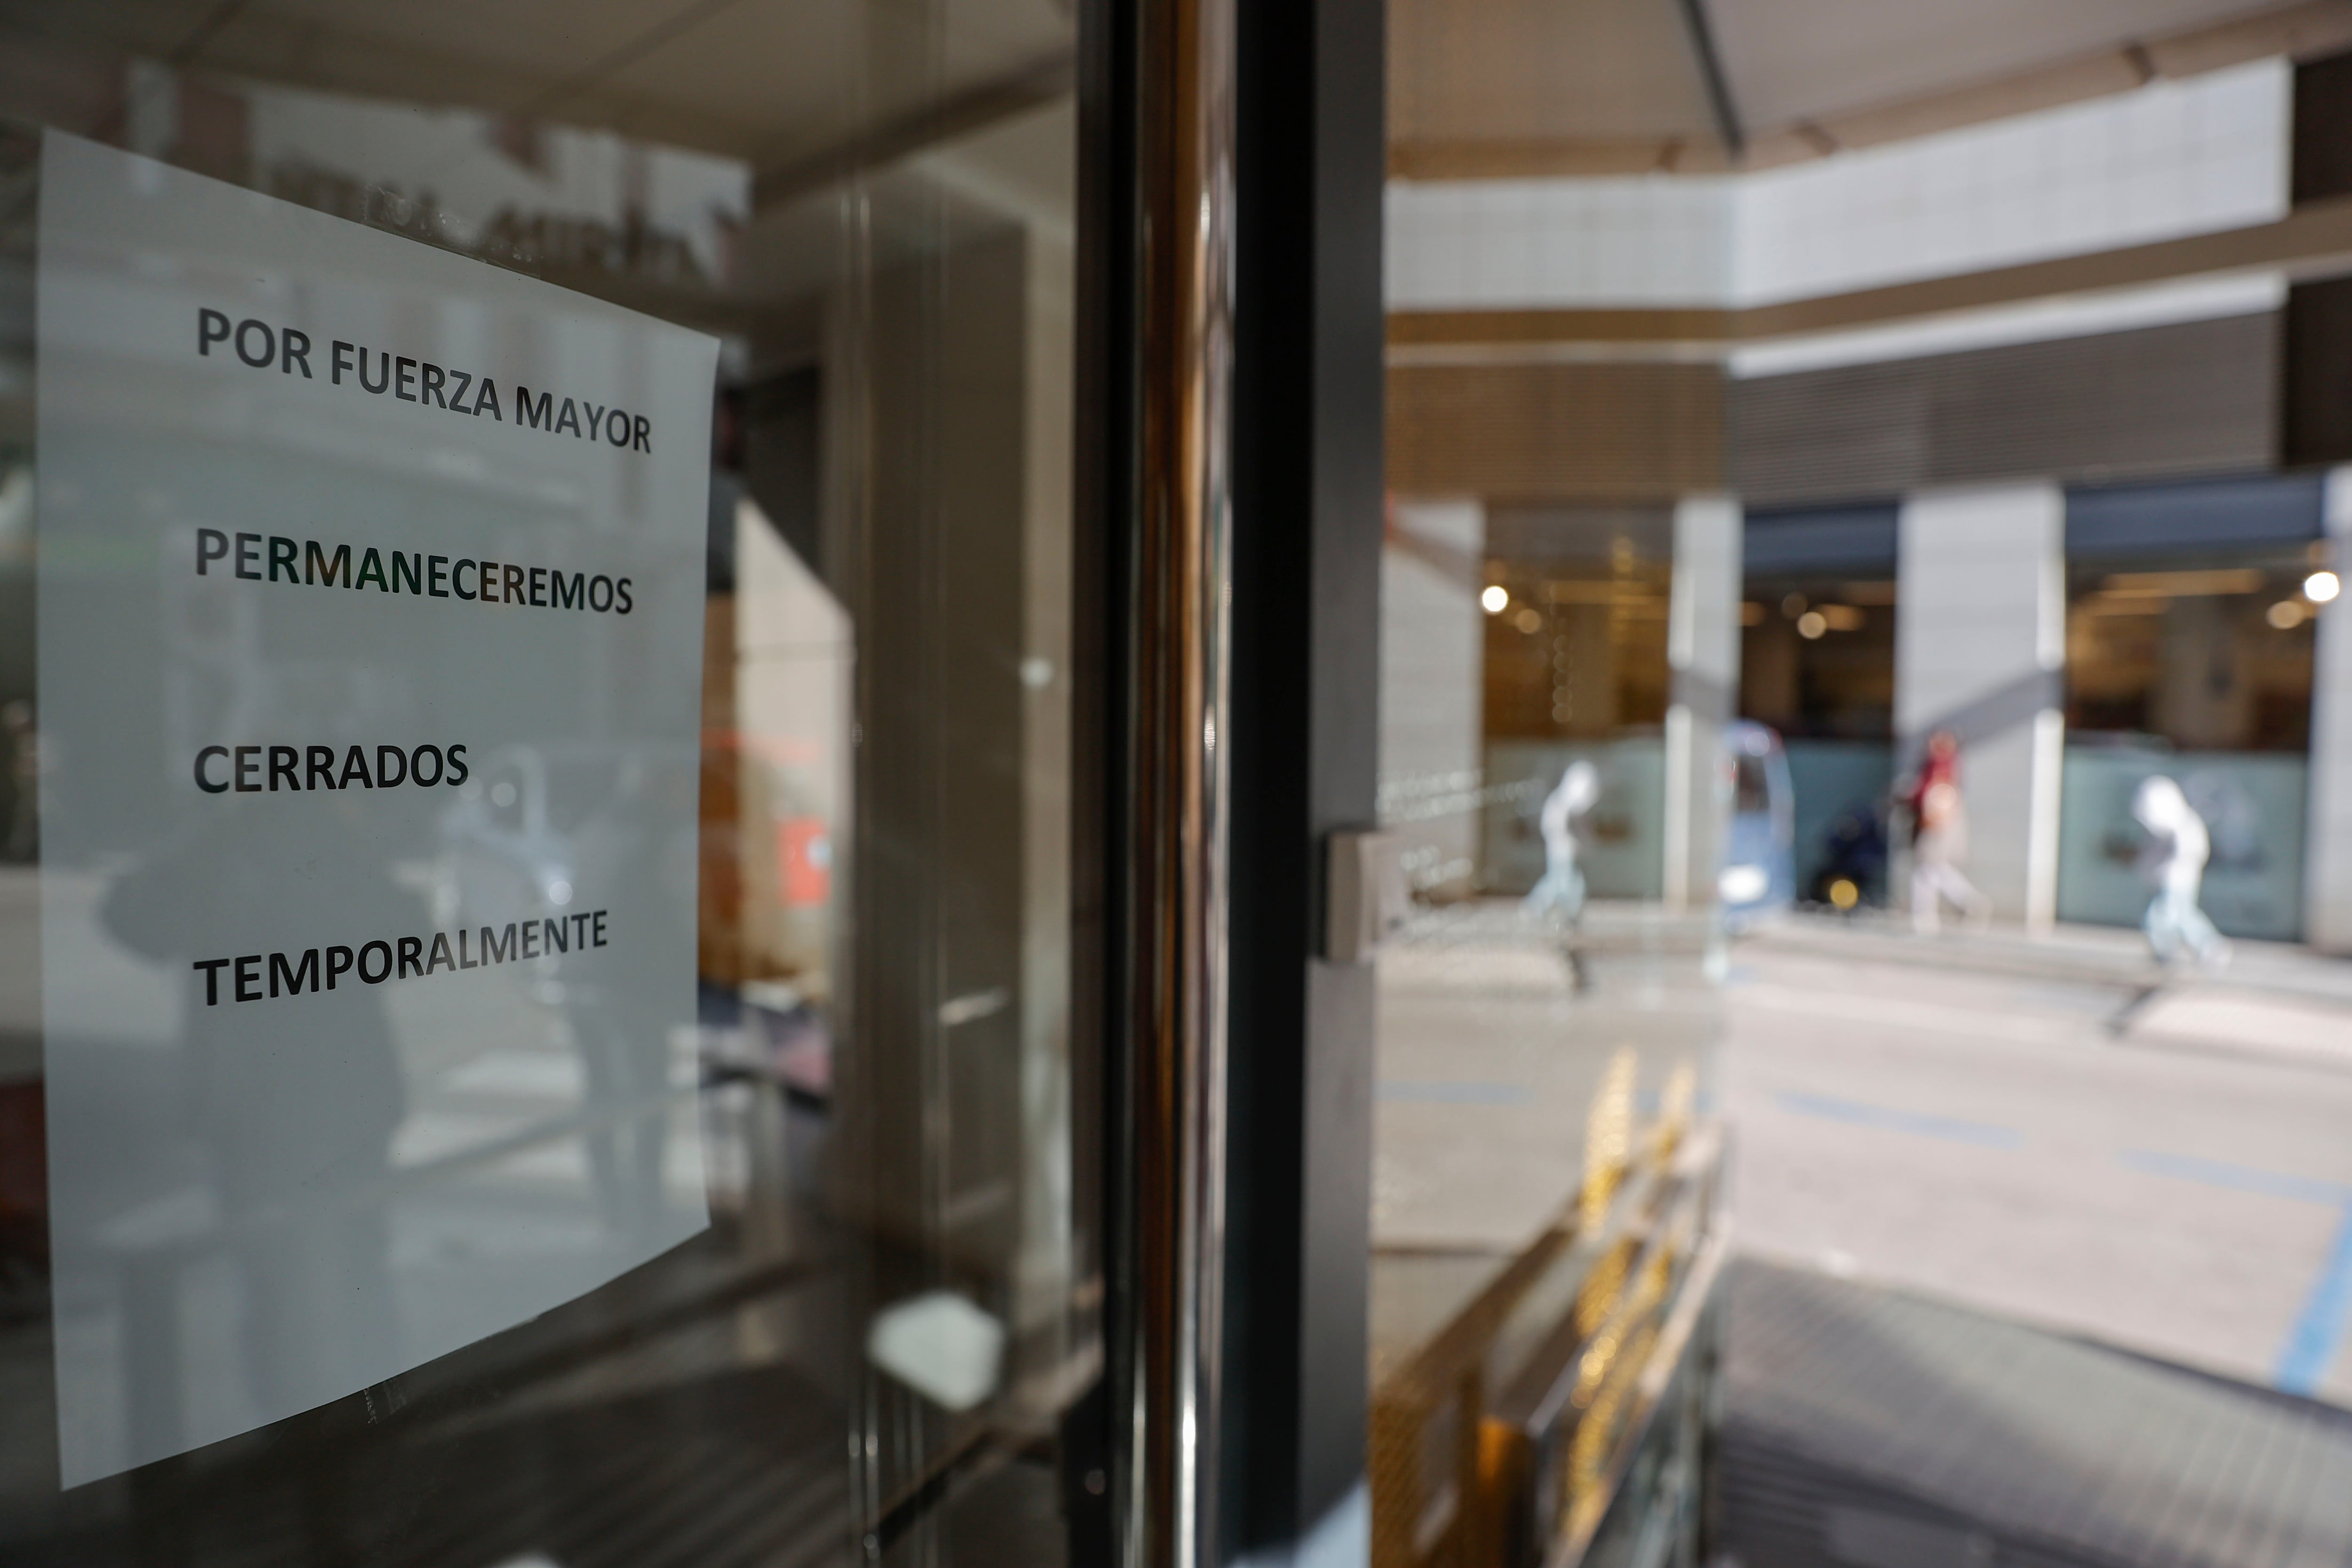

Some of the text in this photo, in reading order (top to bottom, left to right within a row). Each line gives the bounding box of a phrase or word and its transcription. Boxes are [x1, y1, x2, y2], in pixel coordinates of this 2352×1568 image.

[198, 307, 651, 454] POR FUERZA MAYOR
[196, 527, 633, 615] PERMANECEREMOS
[193, 743, 469, 794] CERRADOS
[192, 909, 608, 1006] TEMPORALMENTE
